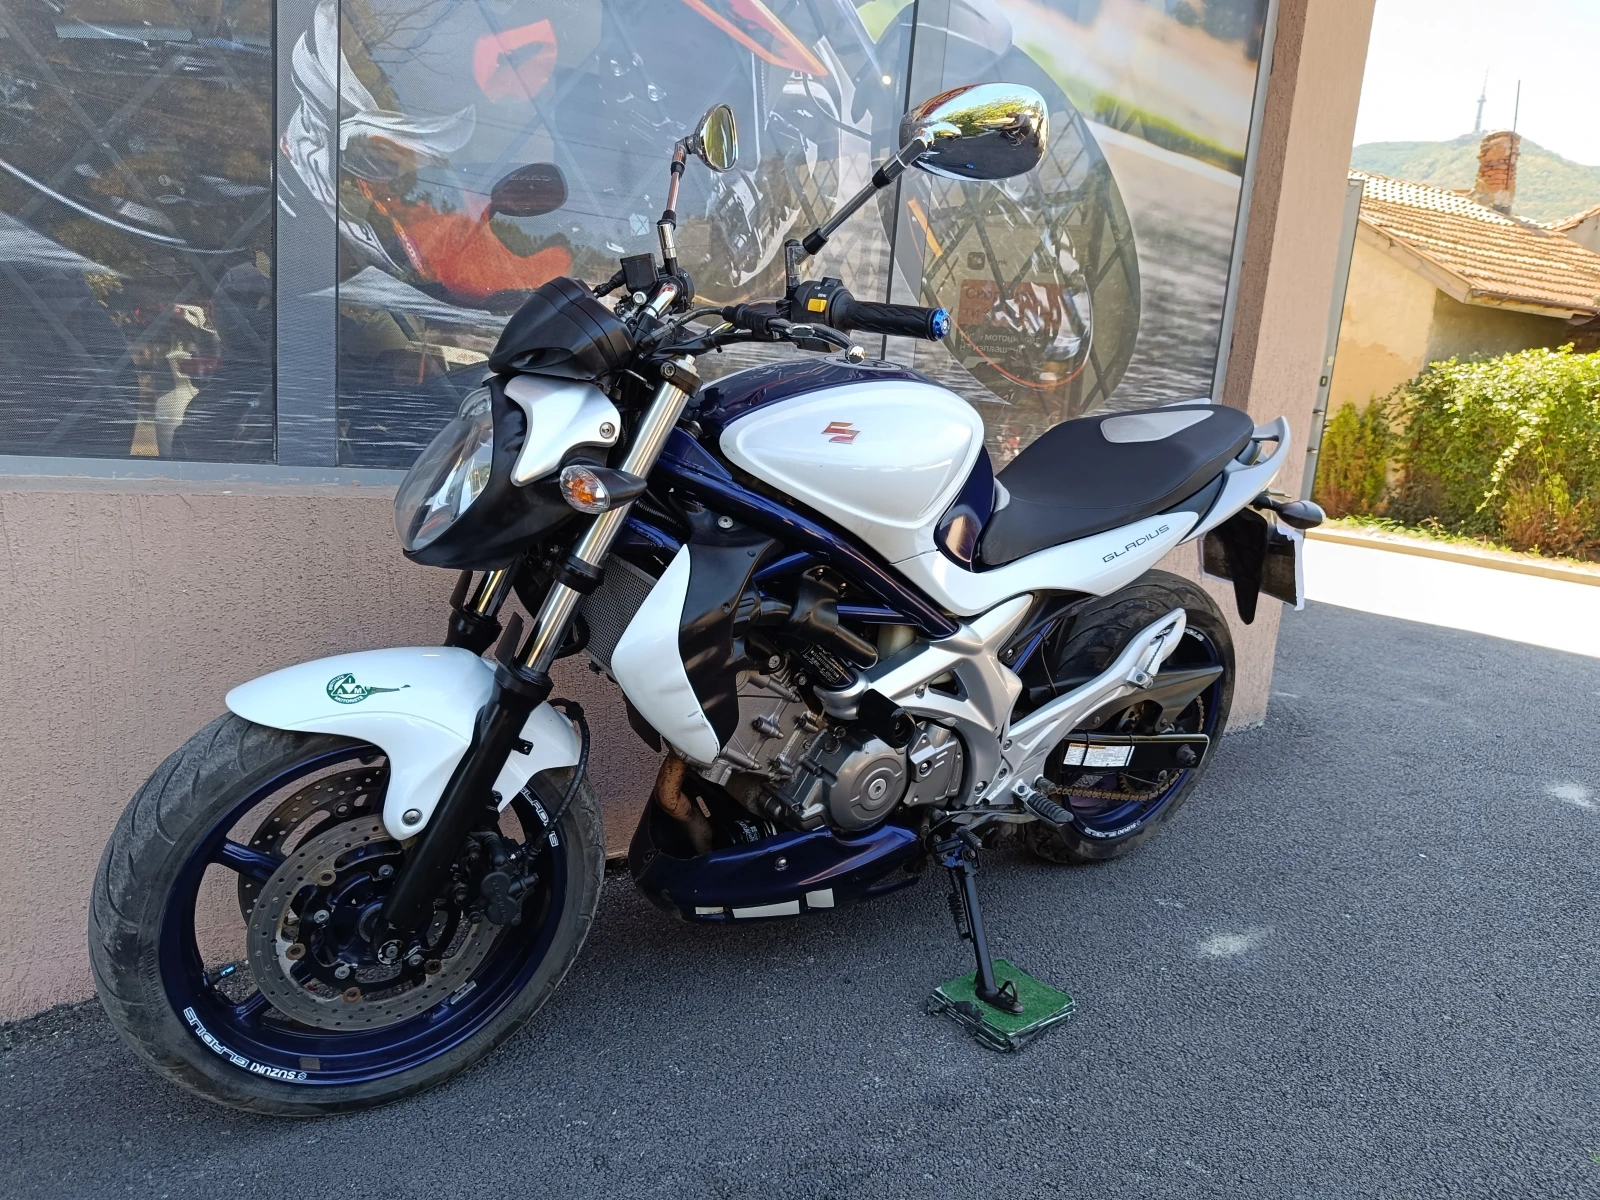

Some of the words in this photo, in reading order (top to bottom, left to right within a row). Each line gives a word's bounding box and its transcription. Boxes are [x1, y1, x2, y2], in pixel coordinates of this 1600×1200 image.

[1102, 524, 1170, 563] GLADIUS
[183, 1006, 250, 1068] GLADIUS
[249, 1062, 297, 1080] SUZUKI
